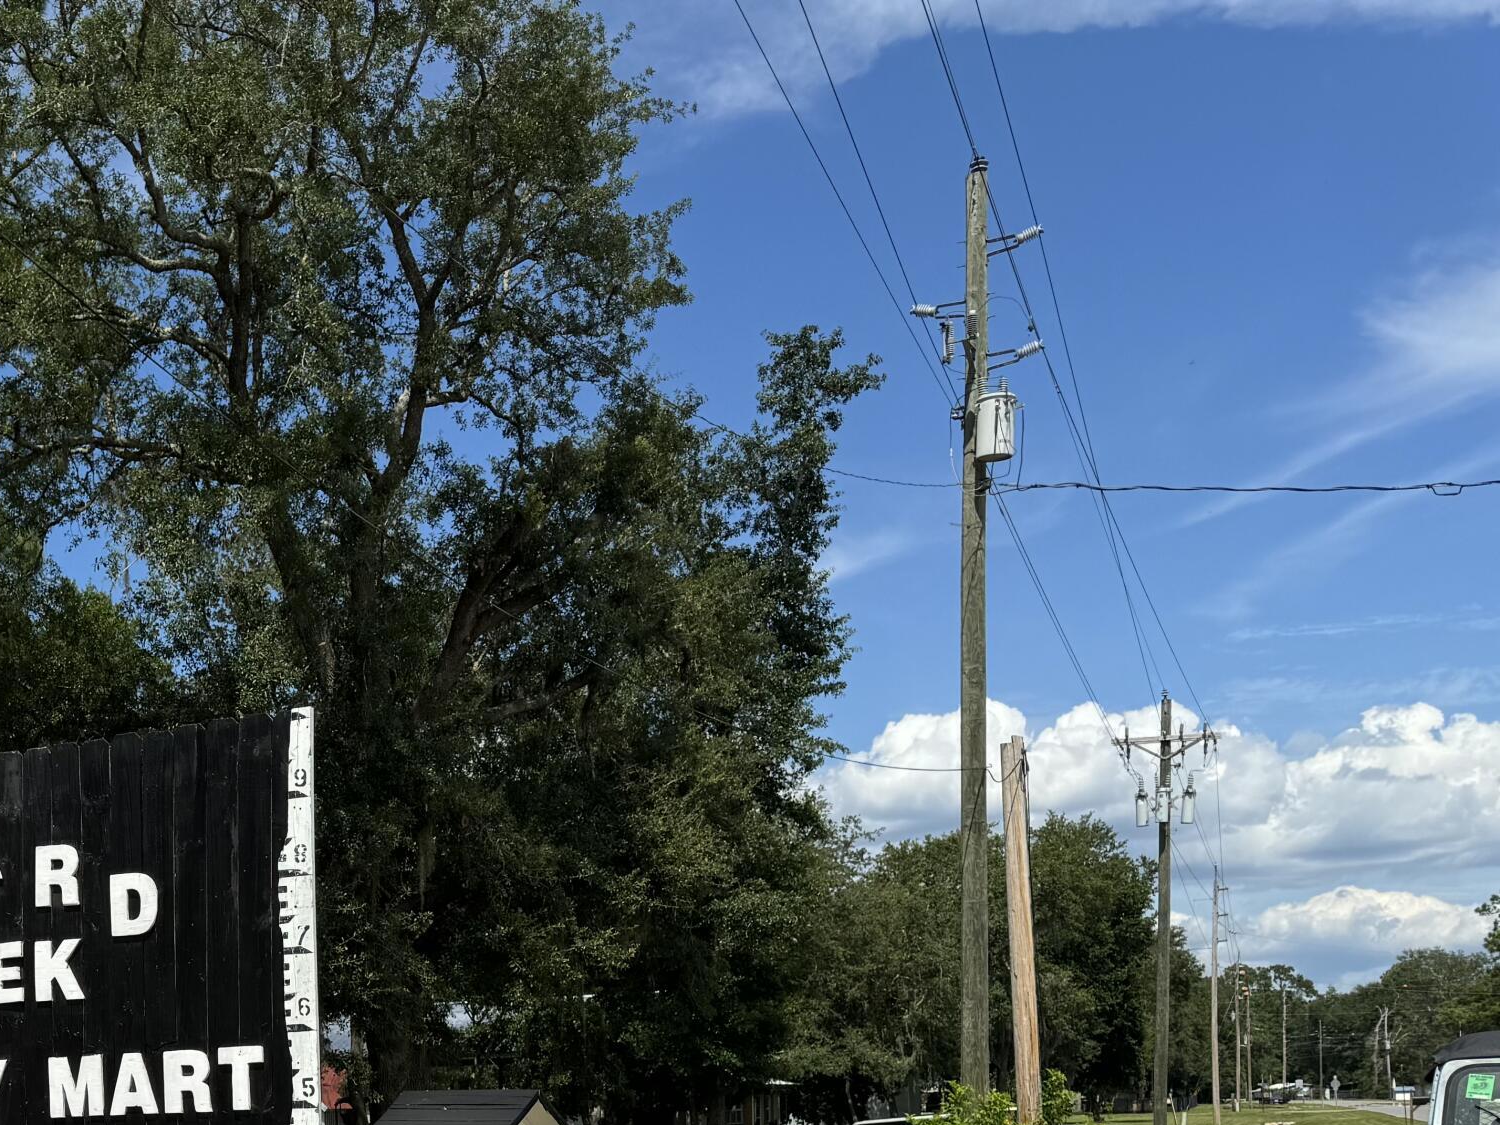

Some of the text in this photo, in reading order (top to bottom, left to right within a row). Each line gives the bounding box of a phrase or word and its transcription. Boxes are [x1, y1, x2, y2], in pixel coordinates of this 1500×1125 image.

[293, 768, 307, 787] 9
[297, 924, 311, 946] 7
[298, 997, 311, 1016] 6
[47, 1045, 265, 1119] MART
[301, 1077, 315, 1098] 5
